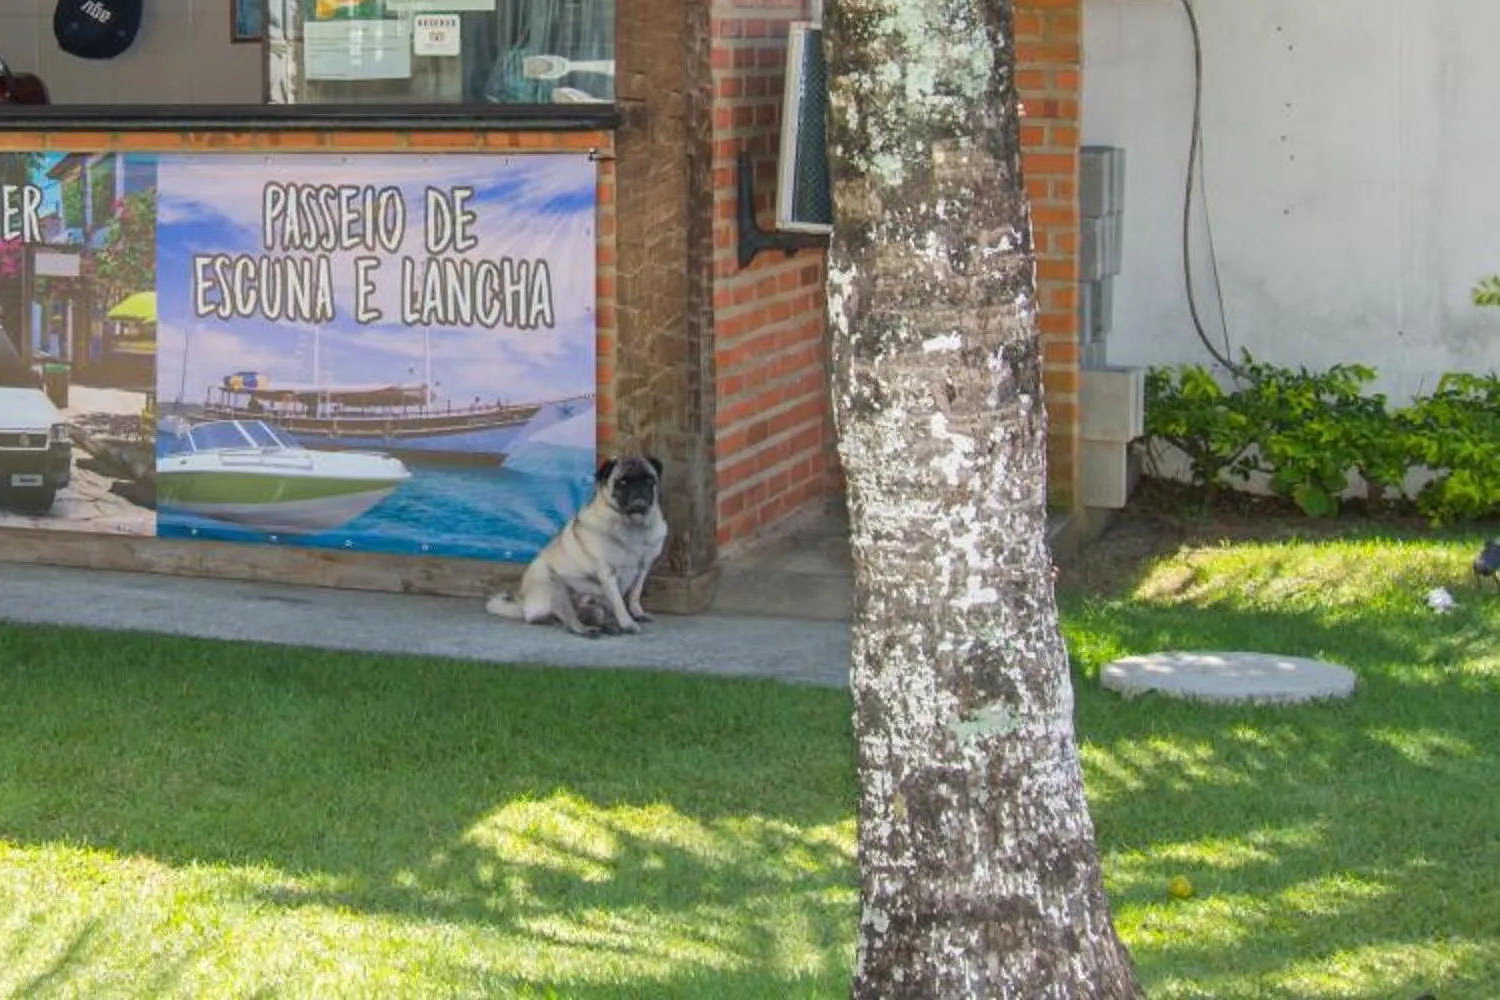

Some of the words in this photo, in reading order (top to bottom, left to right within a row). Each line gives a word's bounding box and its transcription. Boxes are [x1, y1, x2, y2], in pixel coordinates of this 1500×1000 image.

[262, 181, 406, 252] PASSEIO
[425, 186, 478, 254] DE
[193, 254, 336, 322] ESCUNA
[354, 256, 382, 325] E
[403, 255, 554, 329] LANCHA
